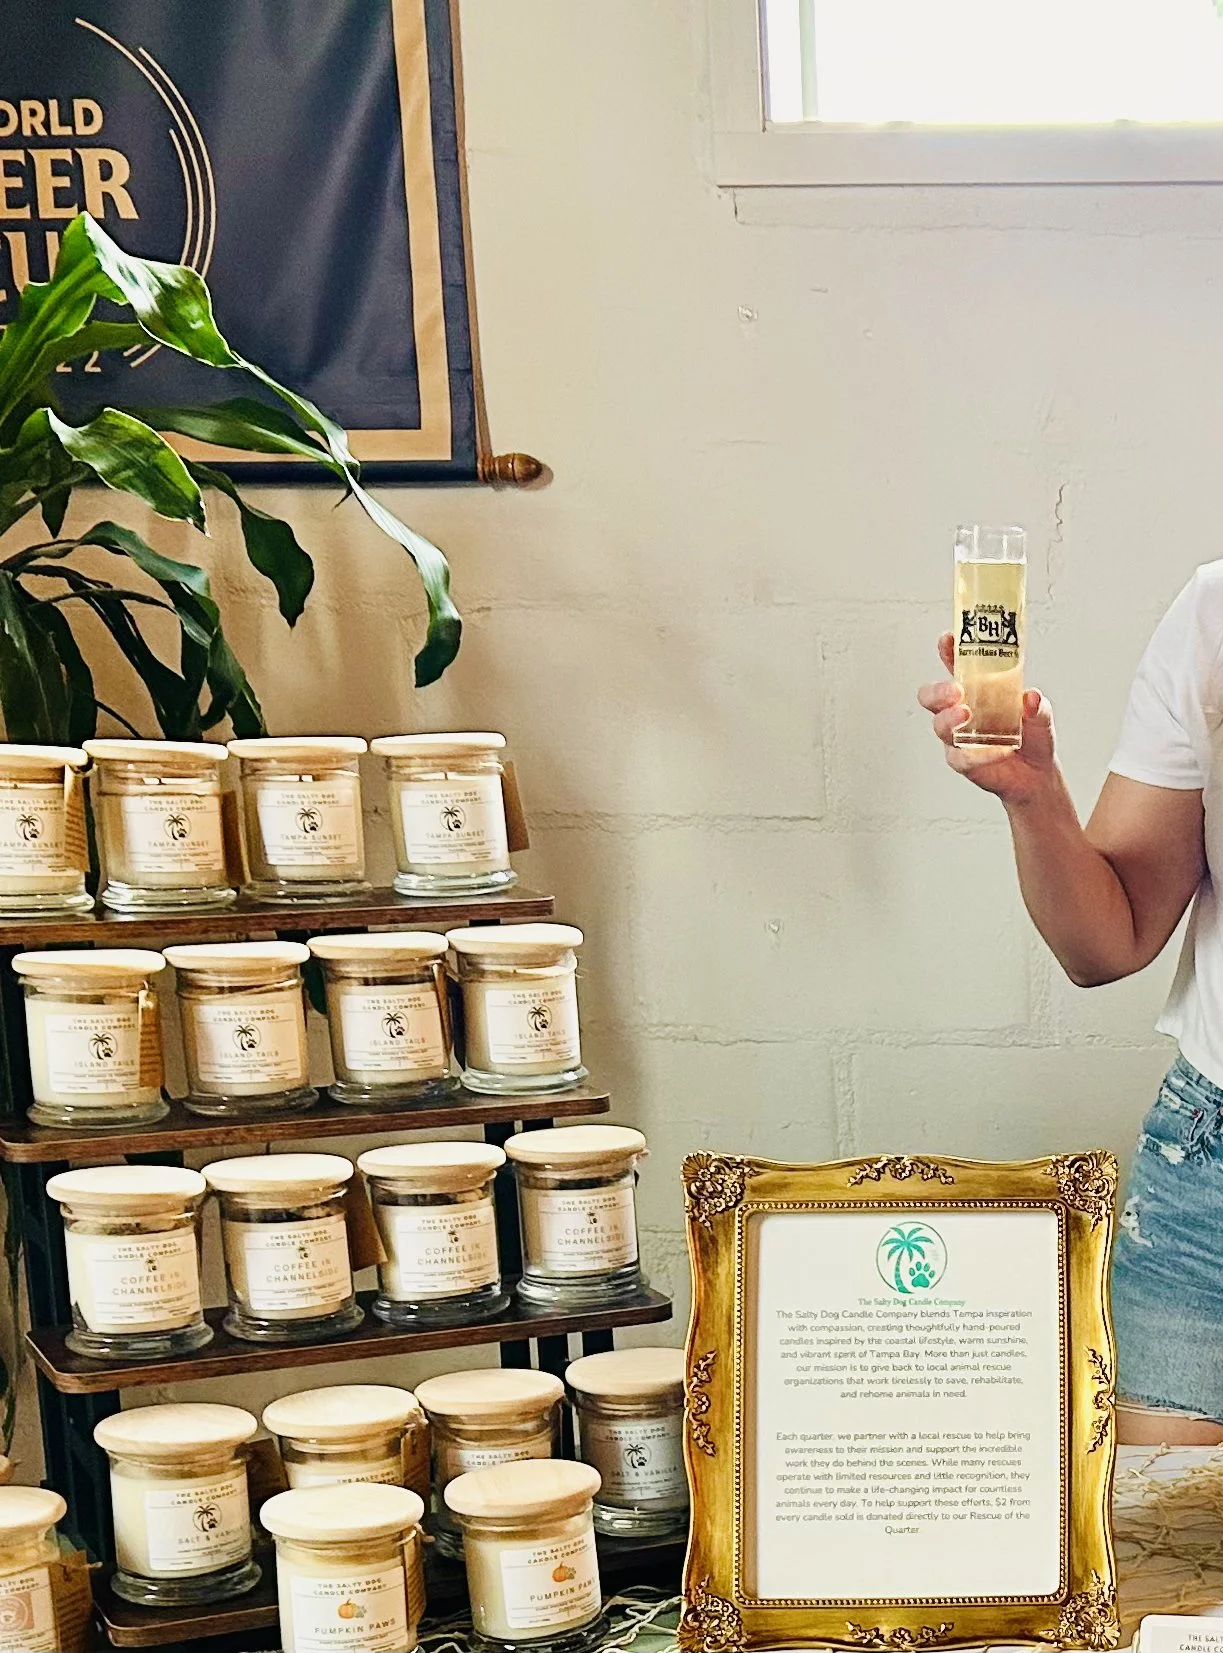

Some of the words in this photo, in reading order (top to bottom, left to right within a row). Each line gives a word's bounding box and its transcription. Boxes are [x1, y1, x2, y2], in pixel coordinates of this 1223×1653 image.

[0, 98, 104, 137] ORLD
[0, 148, 140, 220] EER
[977, 616, 999, 637] BH
[564, 1226, 605, 1236] COFFEE
[425, 1245, 466, 1255] COFFEE
[274, 1261, 317, 1272] COFFEE
[120, 1273, 165, 1285] COFFEE
[775, 1309, 793, 1319] The
[794, 1309, 818, 1320] Salty
[820, 1309, 840, 1320] Dog
[841, 1309, 873, 1319] Candle
[875, 1309, 918, 1320] Company
[919, 1309, 951, 1318] blends
[951, 1308, 984, 1320] Tampa
[985, 1308, 1032, 1319] inspiration
[787, 1323, 808, 1331] with
[809, 1323, 865, 1333] compassion,
[904, 1322, 960, 1333] thoughtfully
[779, 1336, 814, 1345] candles
[815, 1336, 852, 1346] inspired
[853, 1336, 865, 1346] by
[866, 1336, 882, 1345] the
[883, 1335, 916, 1345] coastal
[918, 1335, 956, 1346] lifestyle,
[986, 1335, 1028, 1344] sunshine,
[780, 1350, 798, 1359] and
[799, 1350, 831, 1359] vibrant
[857, 1349, 867, 1358] of
[868, 1349, 901, 1360] Tampa
[924, 1349, 947, 1358] More
[949, 1349, 970, 1358] than
[970, 1349, 989, 1359] just
[530, 1587, 576, 1602] PUMPKIN
[314, 1625, 365, 1636] PUMPKIN
[369, 1618, 397, 1632] PAWS
[1187, 1634, 1202, 1642] THE
[1179, 1643, 1211, 1652] CANDLE
